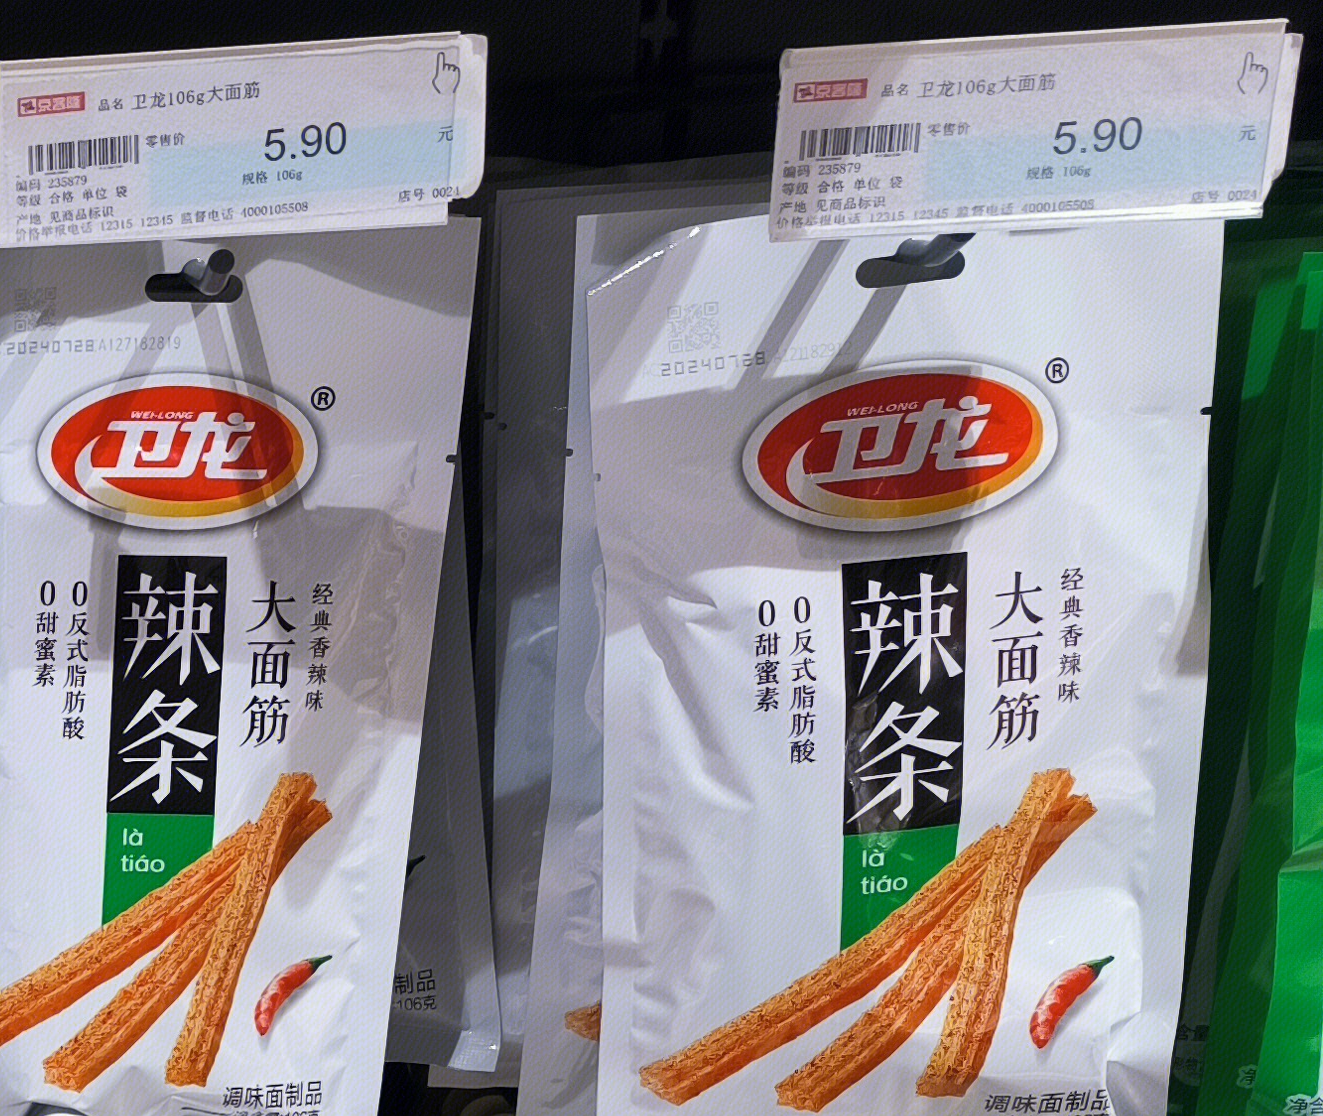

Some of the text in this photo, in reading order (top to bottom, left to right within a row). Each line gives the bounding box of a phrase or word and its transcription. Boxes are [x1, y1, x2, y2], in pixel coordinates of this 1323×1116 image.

[98, 81, 260, 112] 品名 卫龙106g大面筋
[881, 73, 1055, 98] 品名 卫龙106g大面筋
[145, 131, 185, 148] 零售价
[264, 121, 347, 161] 5.90
[438, 126, 454, 142] 元
[928, 122, 970, 138] 零售价
[1053, 117, 1143, 155] 5.90
[1239, 125, 1256, 142] 元
[48, 175, 88, 189] 235879
[276, 169, 303, 183] 106g
[818, 162, 860, 176] 235879
[1063, 165, 1091, 179] 106g
[100, 217, 133, 231] 12315
[100, 411, 270, 480] 卫龙
[808, 396, 1010, 485] 卫龙
[32, 580, 59, 688] 0甜蜜素
[305, 582, 334, 711] 经典香辣味
[1058, 567, 1085, 704] 经典香辣味
[62, 580, 88, 740] 0反式脂肪酸
[240, 579, 296, 748] 大面筋
[754, 600, 782, 713] 0甜蜜素
[987, 571, 1044, 751] 大面筋
[109, 571, 222, 804] 辣条
[789, 595, 817, 764] 0反式脂肪酸
[846, 572, 965, 821] 辣条
[122, 827, 144, 848] là
[120, 853, 165, 874] tiáo
[861, 847, 886, 868] là
[861, 871, 908, 895] tiáo
[222, 1080, 323, 1112] 调味面制品
[984, 1089, 1110, 1114] 调味面制品
